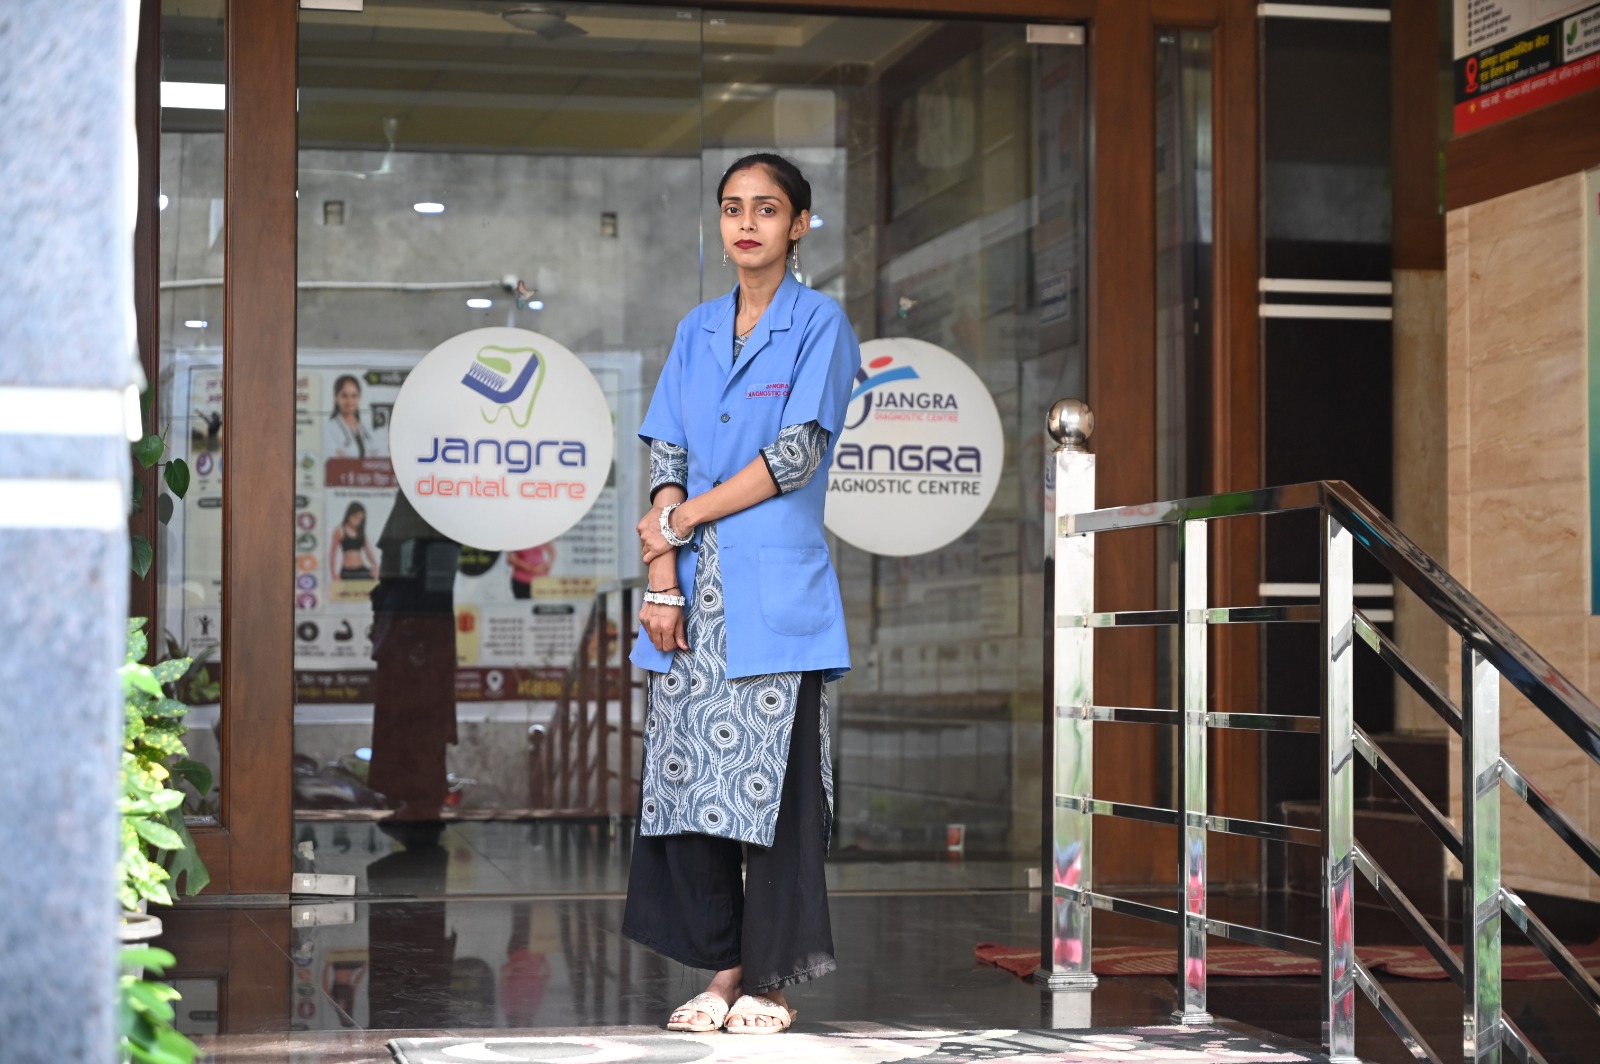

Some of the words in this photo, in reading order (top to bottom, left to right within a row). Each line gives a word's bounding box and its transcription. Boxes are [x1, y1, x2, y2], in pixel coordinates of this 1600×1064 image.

[874, 391, 959, 410] JANGRA
[874, 412, 924, 421] DIAGNOSTIC
[927, 413, 959, 422] CENTRE
[417, 436, 587, 474] Jangra
[417, 474, 509, 497] dental
[519, 480, 587, 499] care
[917, 480, 981, 496] CENTRE
